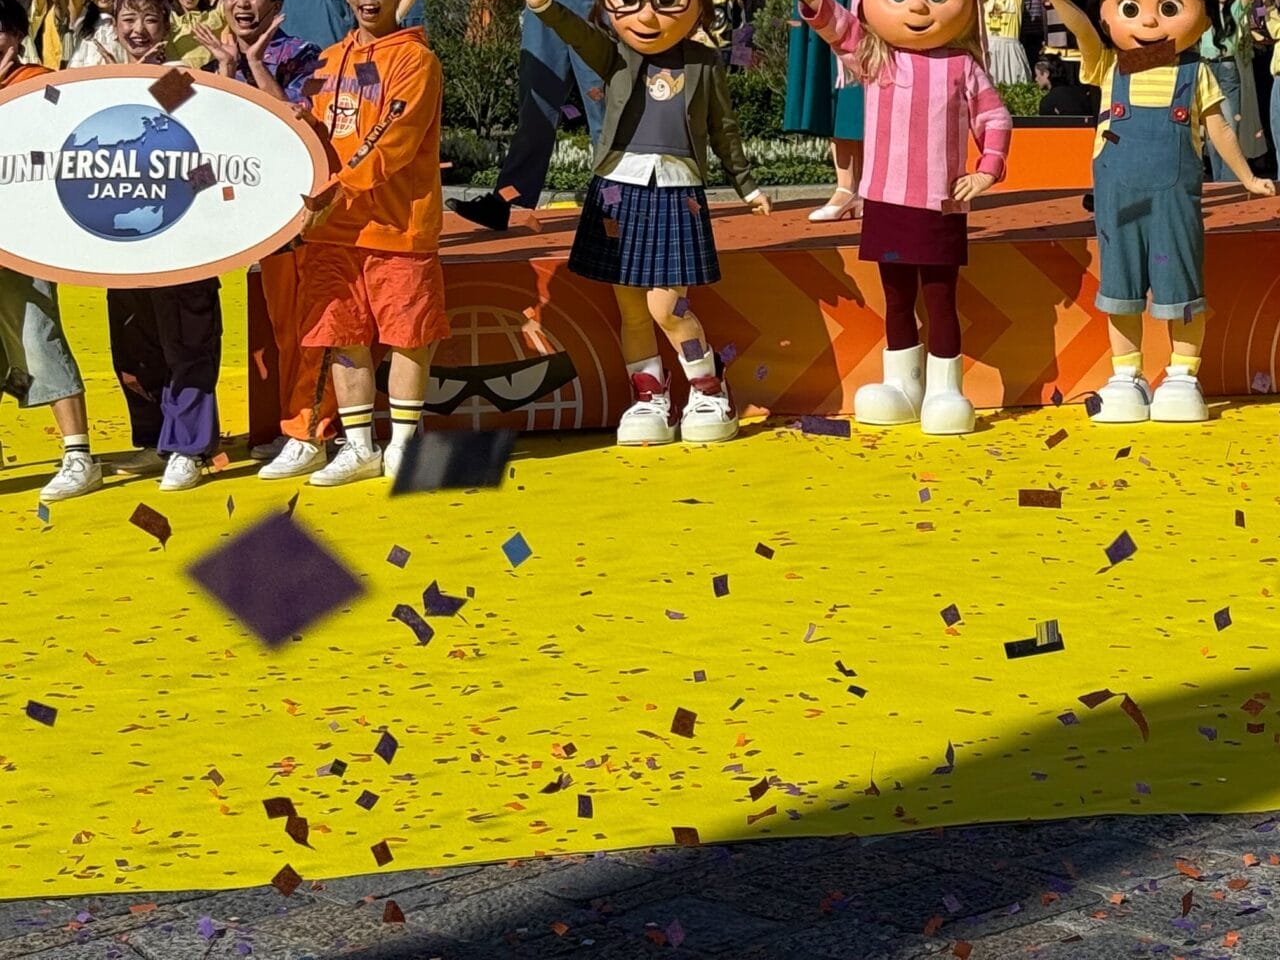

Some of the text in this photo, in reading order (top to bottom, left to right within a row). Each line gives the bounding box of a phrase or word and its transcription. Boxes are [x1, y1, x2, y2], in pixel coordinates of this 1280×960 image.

[0, 148, 262, 187] UNIVERSAL STUDIOS
[87, 182, 167, 200] JAPAN
